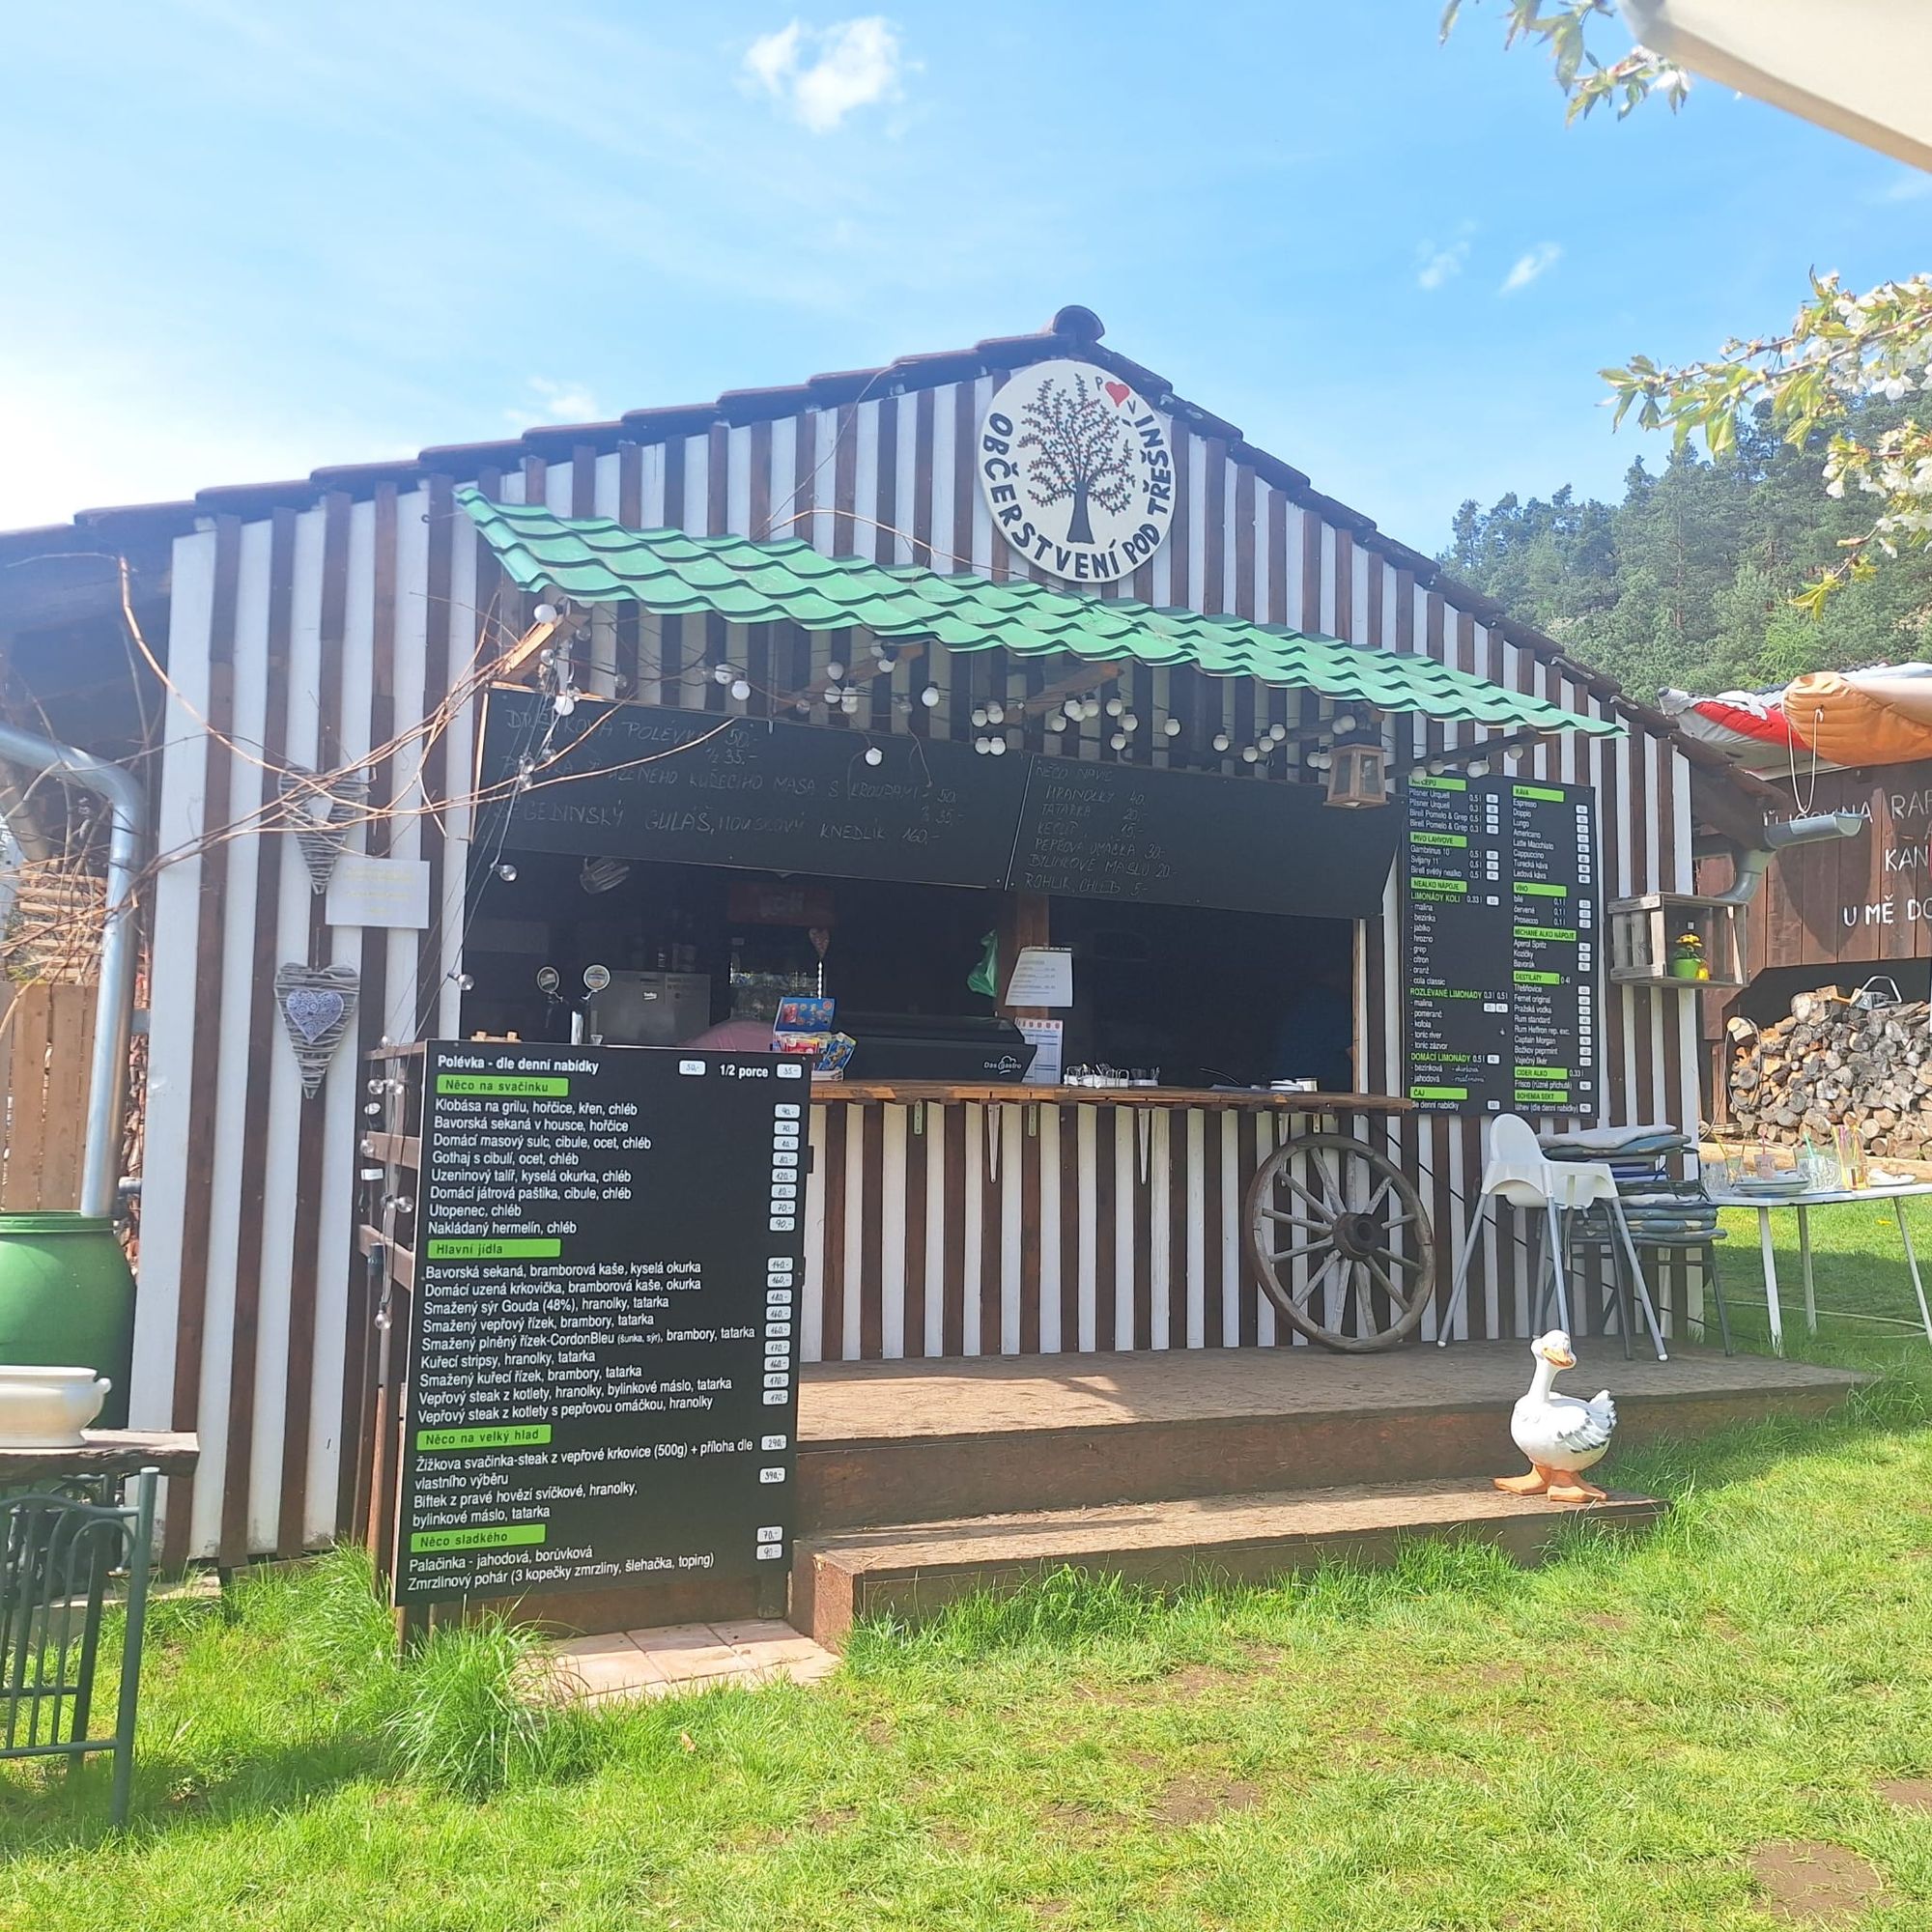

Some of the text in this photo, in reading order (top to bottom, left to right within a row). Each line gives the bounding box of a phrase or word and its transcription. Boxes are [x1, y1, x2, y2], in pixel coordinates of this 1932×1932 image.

[982, 412, 1122, 580] OBČERSTVENÍ
[1122, 523, 1160, 565] POD
[1843, 906, 1858, 927] U
[1864, 894, 1894, 925] MĚ
[437, 1054, 484, 1068] Polévka
[496, 1056, 515, 1069] dle
[517, 1057, 551, 1070] denní
[554, 1059, 599, 1075] nabídky
[720, 1064, 768, 1081] 1/2 porce
[445, 1078, 548, 1092] Něco na svačinku
[435, 1097, 638, 1116] Klobása na grilu, hořčice, křen, chléb
[433, 1132, 651, 1150] Domácí masový sulc, cibule, ocet, chléb
[432, 1150, 579, 1167] Gothaj s cibulí, ocet, chléb
[431, 1168, 631, 1184] Uzeninový talíř, kyselá okurka, chléb
[429, 1203, 522, 1219] Utopenec, chléb
[427, 1220, 577, 1236] Nakládaný hermelín, chléb
[436, 1242, 502, 1257] Hlavní jídla
[421, 1336, 476, 1352] Smažený
[478, 1334, 517, 1351] plněný
[520, 1331, 614, 1347] řízek-CordonBleu
[666, 1327, 717, 1342] brambory,
[720, 1325, 754, 1339] tatarka
[420, 1349, 595, 1370] Kuřecí stripsy, hranolky, tatarka
[425, 1428, 539, 1445] Něco na velký hlad
[415, 1455, 461, 1471] Žižkova
[464, 1451, 549, 1469] svačinka-steak
[551, 1453, 557, 1463] z
[560, 1447, 605, 1465] vepřové
[607, 1445, 651, 1460] krkovice
[653, 1441, 688, 1460] (500g)
[699, 1439, 734, 1457] příloha
[737, 1438, 753, 1451] dle
[414, 1471, 508, 1490] vlastního výběru
[413, 1480, 638, 1509] Biftek z pravé hovězí svíčkové, hranolky,
[412, 1504, 550, 1529] bylinkové máslo, tatarka
[419, 1531, 507, 1548] Něco sladkého
[409, 1555, 466, 1572] Palačinka
[476, 1549, 531, 1570] jahodová,
[535, 1544, 592, 1562] borůvková
[407, 1551, 714, 1590] Zmrzlinový pohár (3 kopečky zmrzliny, šlehačka, toping)
